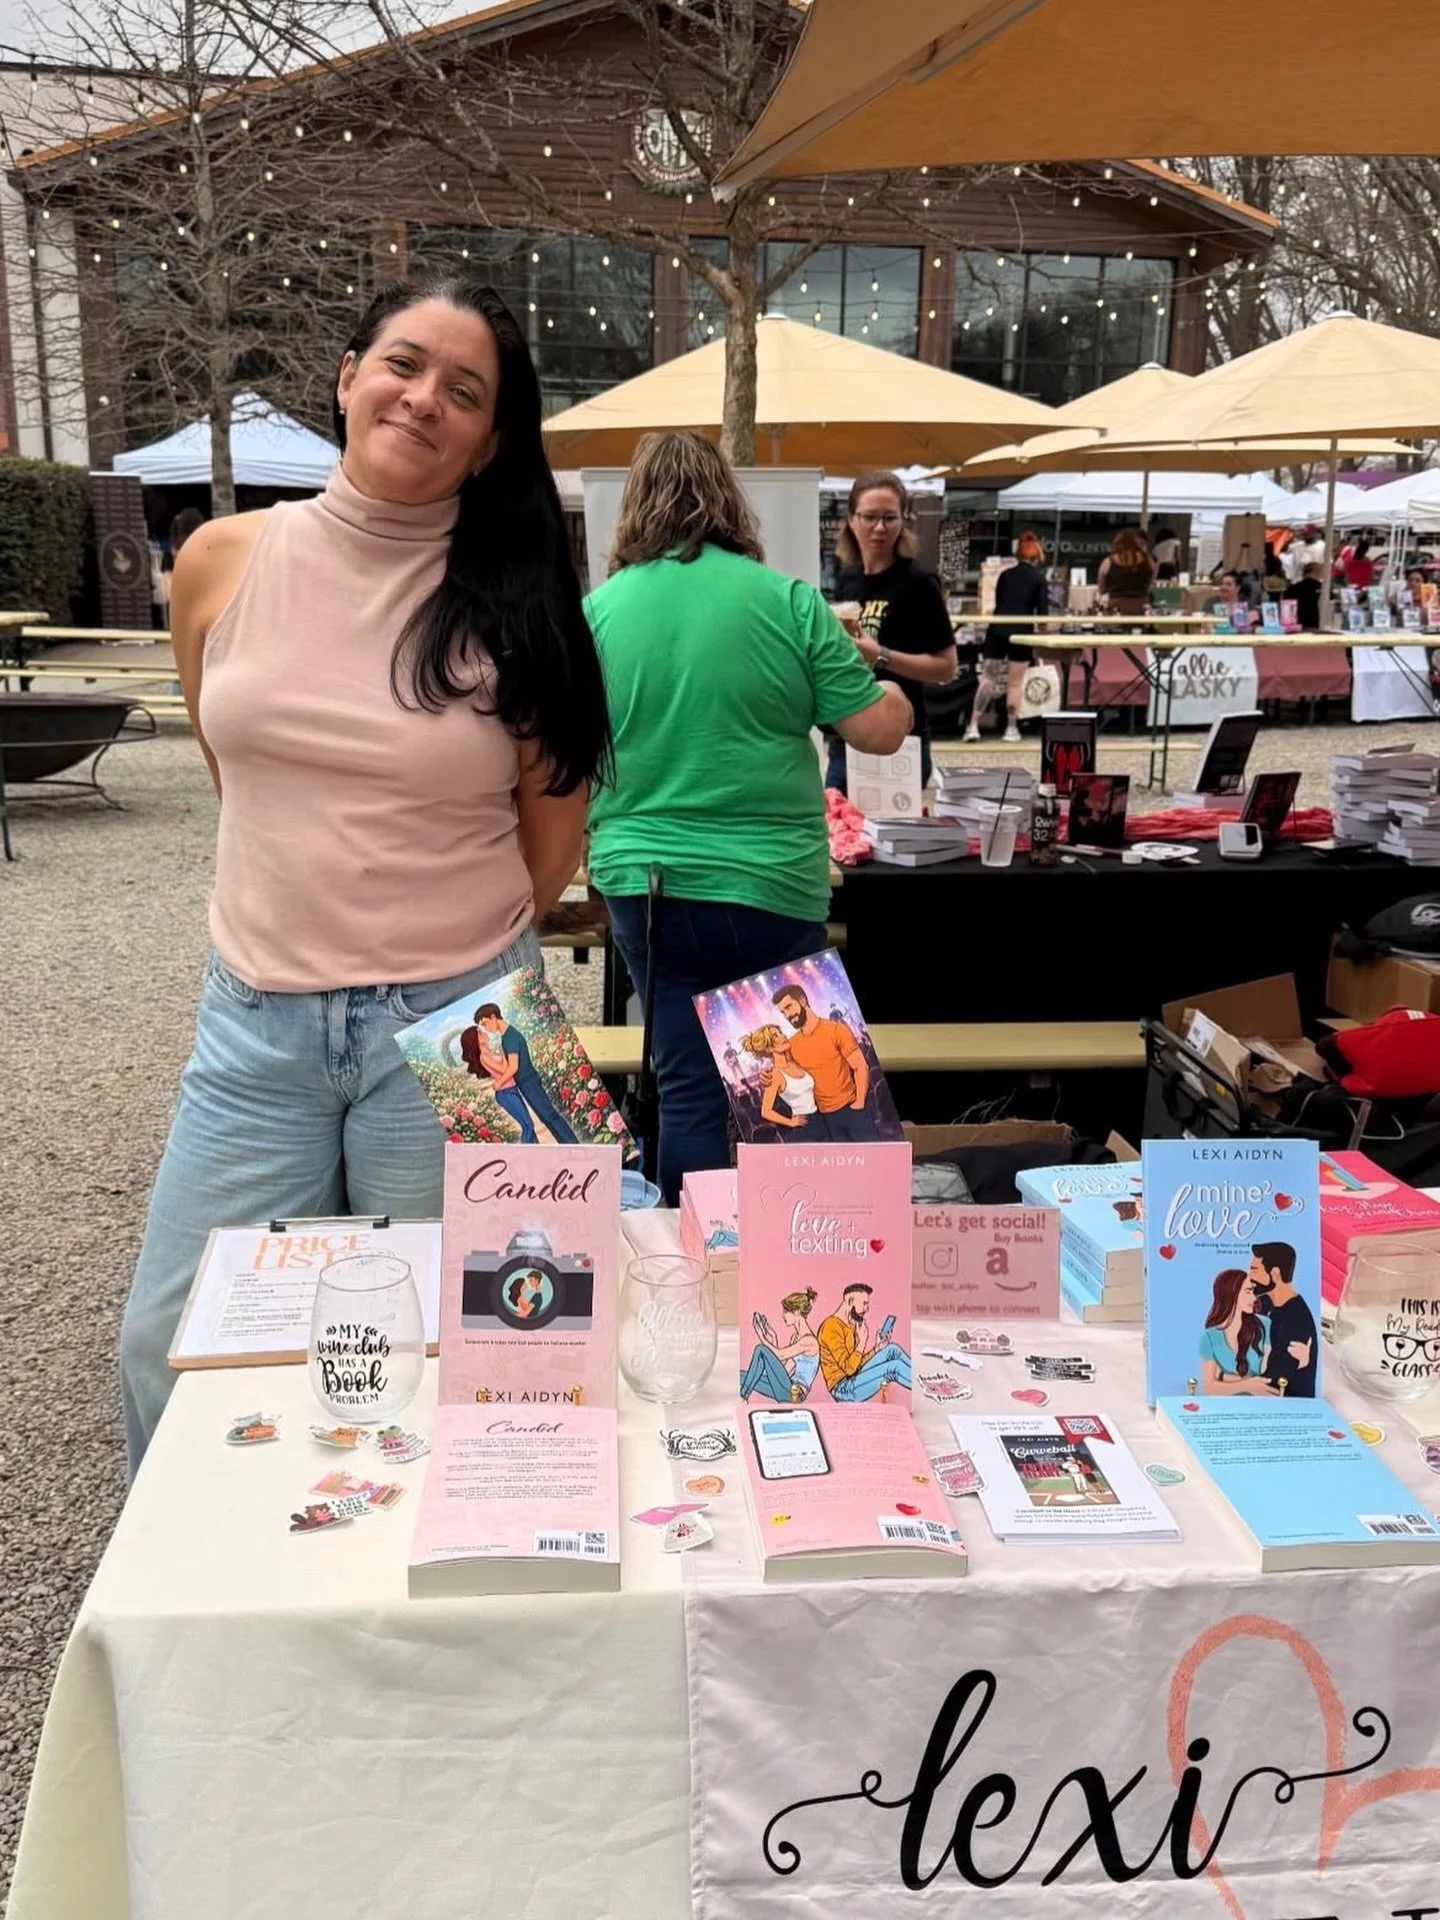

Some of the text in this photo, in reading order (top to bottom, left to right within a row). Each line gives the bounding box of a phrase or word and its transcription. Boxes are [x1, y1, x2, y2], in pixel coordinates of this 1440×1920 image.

[1177, 652, 1231, 678] allie
[784, 1156, 865, 1168] LEXI AIDYN
[1192, 1149, 1284, 1160] LEXI AIDYN
[463, 1159, 600, 1203] Candid
[789, 1199, 841, 1235] love
[1163, 1183, 1272, 1240] love
[914, 1211, 1046, 1233] Let's get social!
[259, 1233, 371, 1253] PRICE
[789, 1233, 868, 1259] texting
[993, 1233, 1043, 1244] Buy Books
[252, 1251, 346, 1271] LIST
[957, 1303, 988, 1315] phone
[1400, 1298, 1428, 1315] THIS
[339, 1323, 362, 1339] MY
[1386, 1313, 1411, 1336] My
[317, 1334, 393, 1358] wine club
[338, 1358, 367, 1369] HAS A
[316, 1356, 389, 1394] Book
[329, 1392, 379, 1405] PROBLEM
[521, 1391, 574, 1402] AIDYN
[486, 1420, 565, 1434] Candid
[1010, 1444, 1076, 1458] Curveball
[762, 1669, 1391, 1891] lexi
